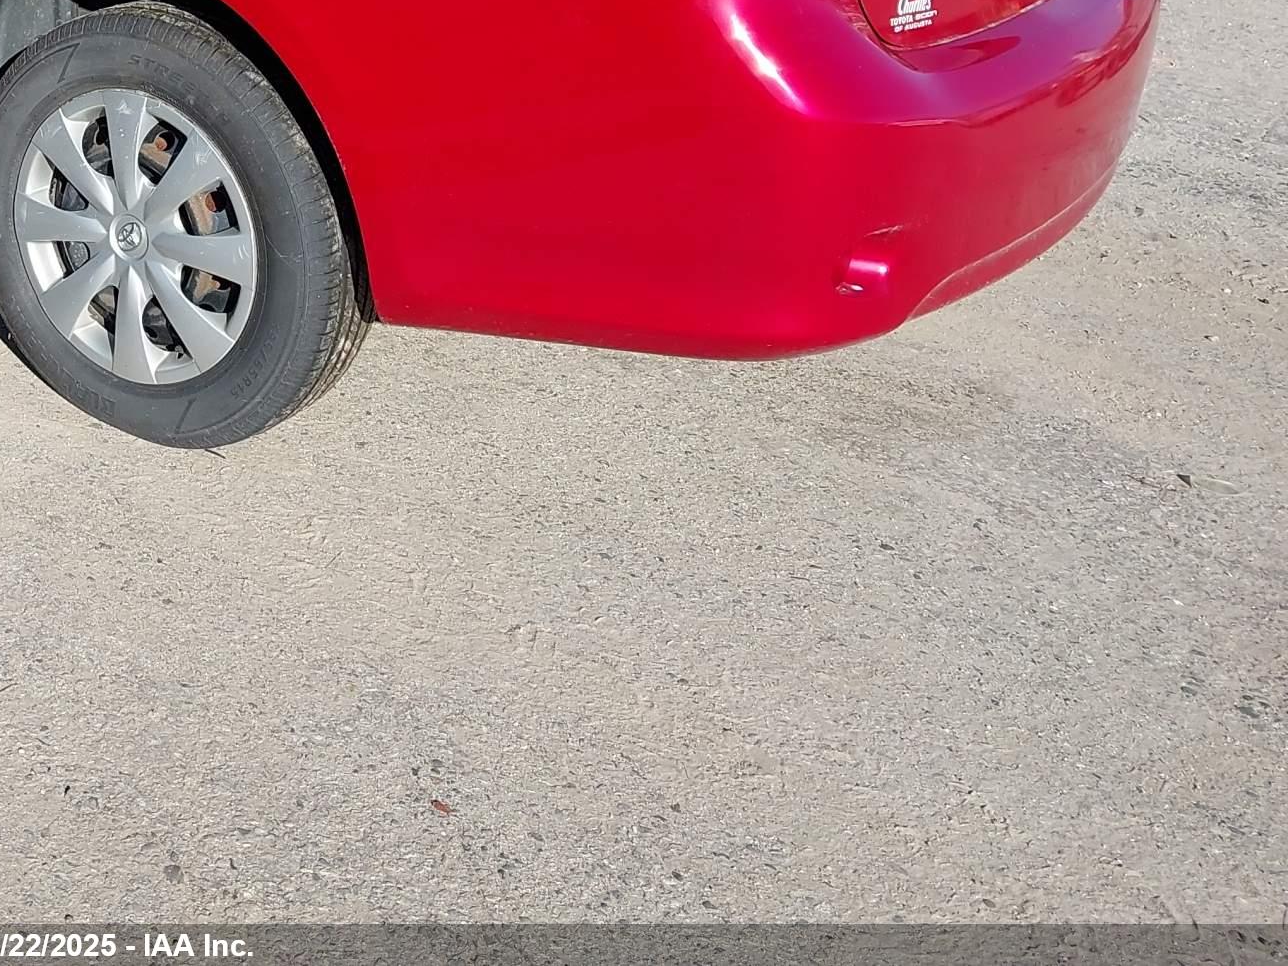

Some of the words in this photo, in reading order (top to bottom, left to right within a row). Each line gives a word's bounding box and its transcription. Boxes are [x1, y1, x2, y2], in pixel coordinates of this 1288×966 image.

[890, 14, 914, 26] TOYOTA
[894, 25, 904, 33] OF
[904, 19, 933, 31] AUGUSTA
